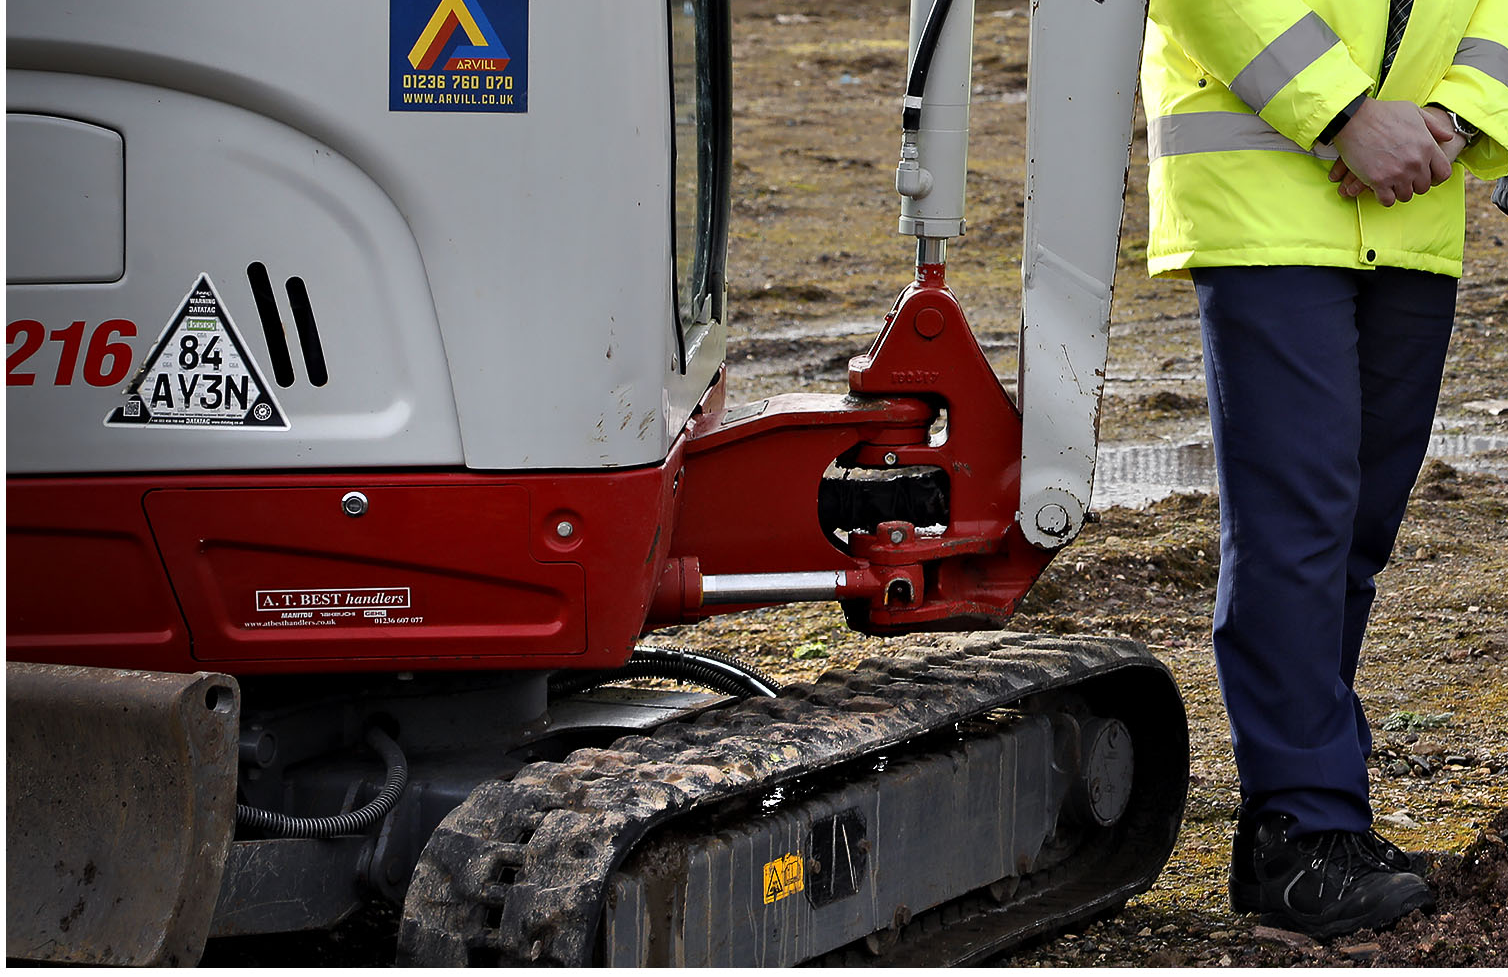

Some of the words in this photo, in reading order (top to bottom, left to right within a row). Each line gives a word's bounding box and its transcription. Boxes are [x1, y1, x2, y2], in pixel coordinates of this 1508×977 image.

[456, 59, 497, 70] ARVILL
[403, 74, 446, 89] 01236
[452, 75, 480, 90] 760
[486, 75, 514, 90] 070
[403, 93, 514, 105] WWW.ARVILL.CO.UK
[6, 318, 139, 388] 216
[178, 334, 223, 371] 84
[151, 373, 249, 411] AY3N
[262, 595, 279, 607] A.
[281, 594, 297, 606] T.
[300, 593, 342, 606] BEST
[345, 592, 404, 605] handlers
[244, 619, 336, 627] www.atbesthandlers.co.uk
